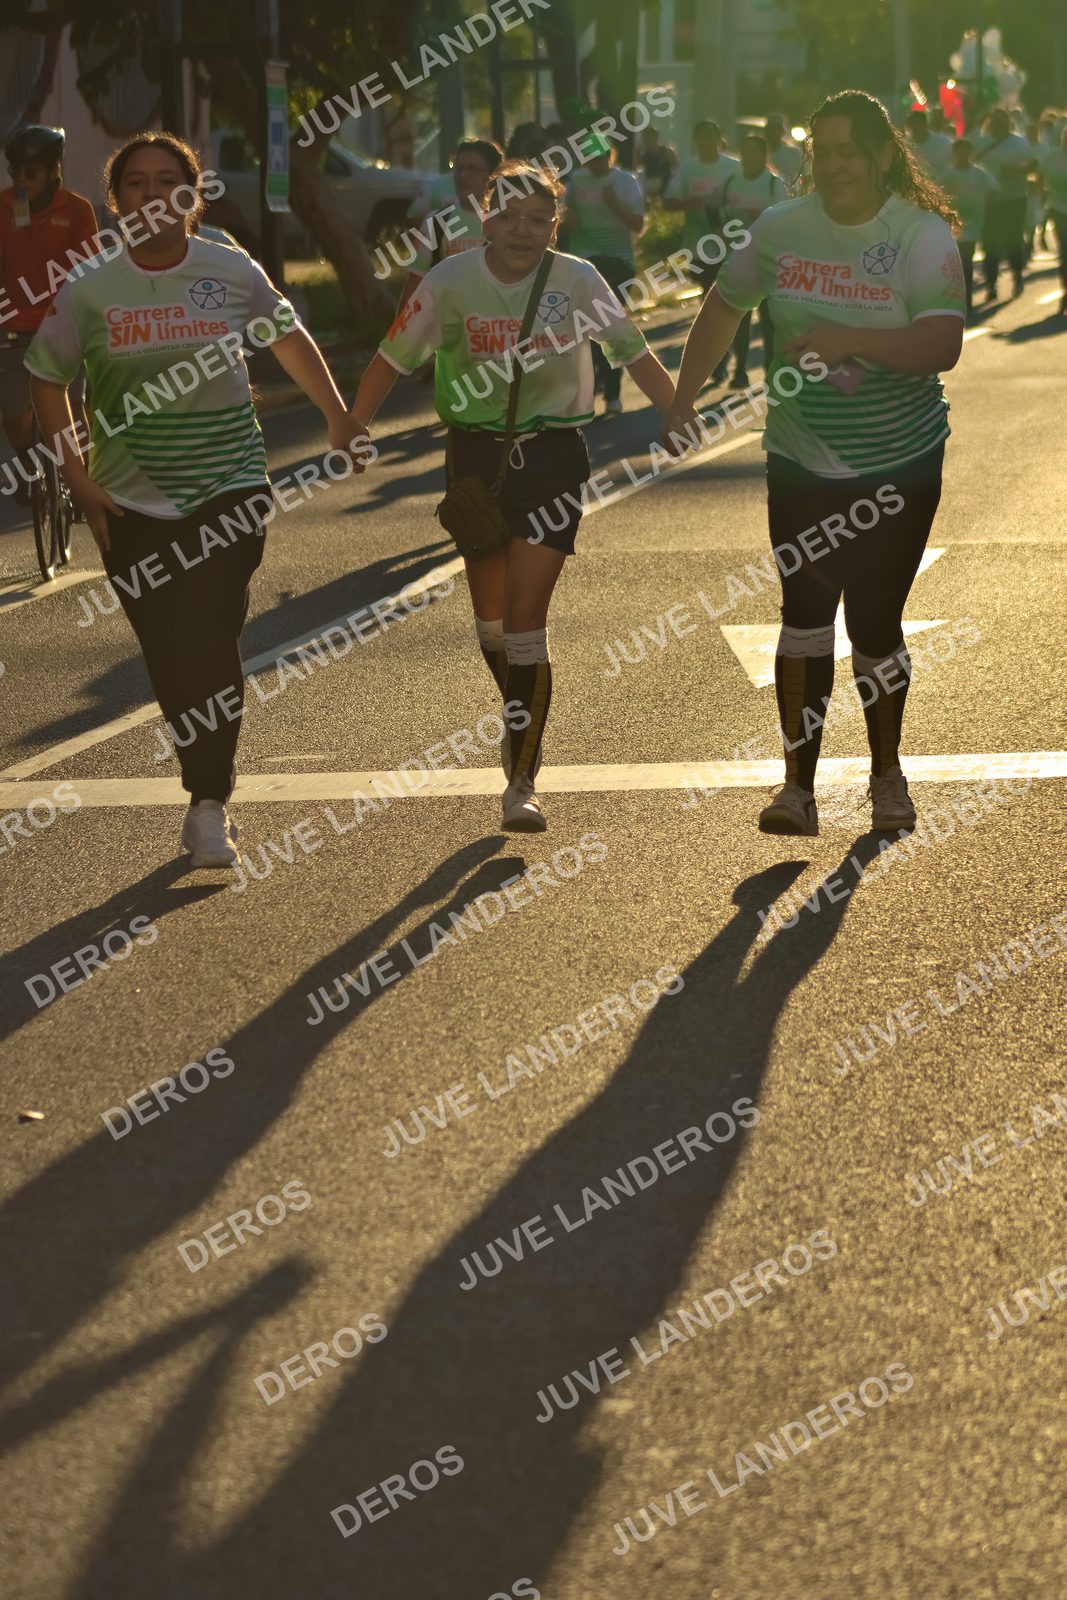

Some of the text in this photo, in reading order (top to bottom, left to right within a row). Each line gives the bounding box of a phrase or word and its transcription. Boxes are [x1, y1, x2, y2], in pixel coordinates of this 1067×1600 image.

[778, 255, 852, 279] Carrera
[777, 271, 817, 292] SIN
[106, 305, 185, 326] Carrera
[466, 316, 523, 333] Carre
[109, 319, 229, 348] SIN límites
[470, 333, 506, 353] SIN
